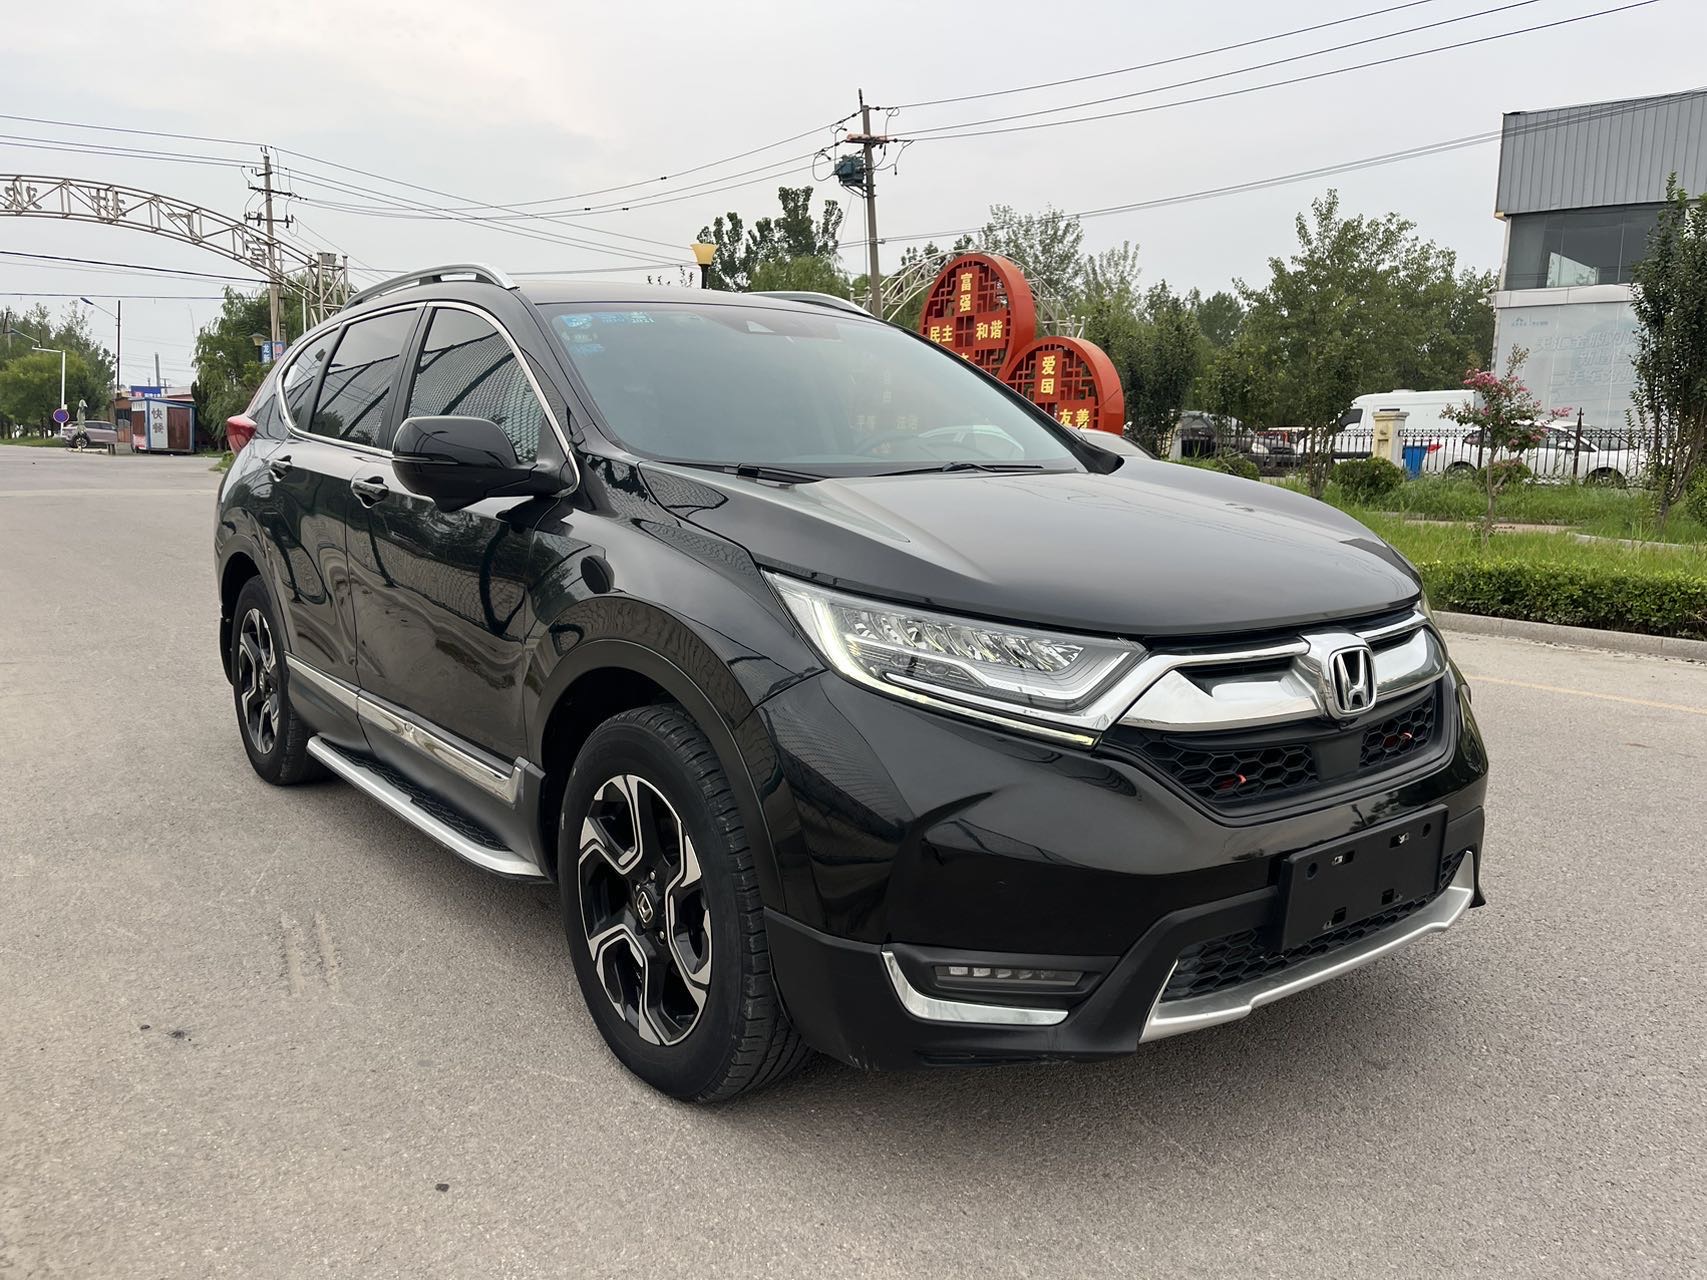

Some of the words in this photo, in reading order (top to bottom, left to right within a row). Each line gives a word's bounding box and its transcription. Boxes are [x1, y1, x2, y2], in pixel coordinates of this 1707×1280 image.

[960, 272, 973, 313] 富强
[929, 324, 953, 344] 民主
[976, 319, 1004, 340] 和谐
[1040, 355, 1057, 395] 爱国
[151, 407, 164, 434] 快餐
[1060, 408, 1090, 429] 友善
